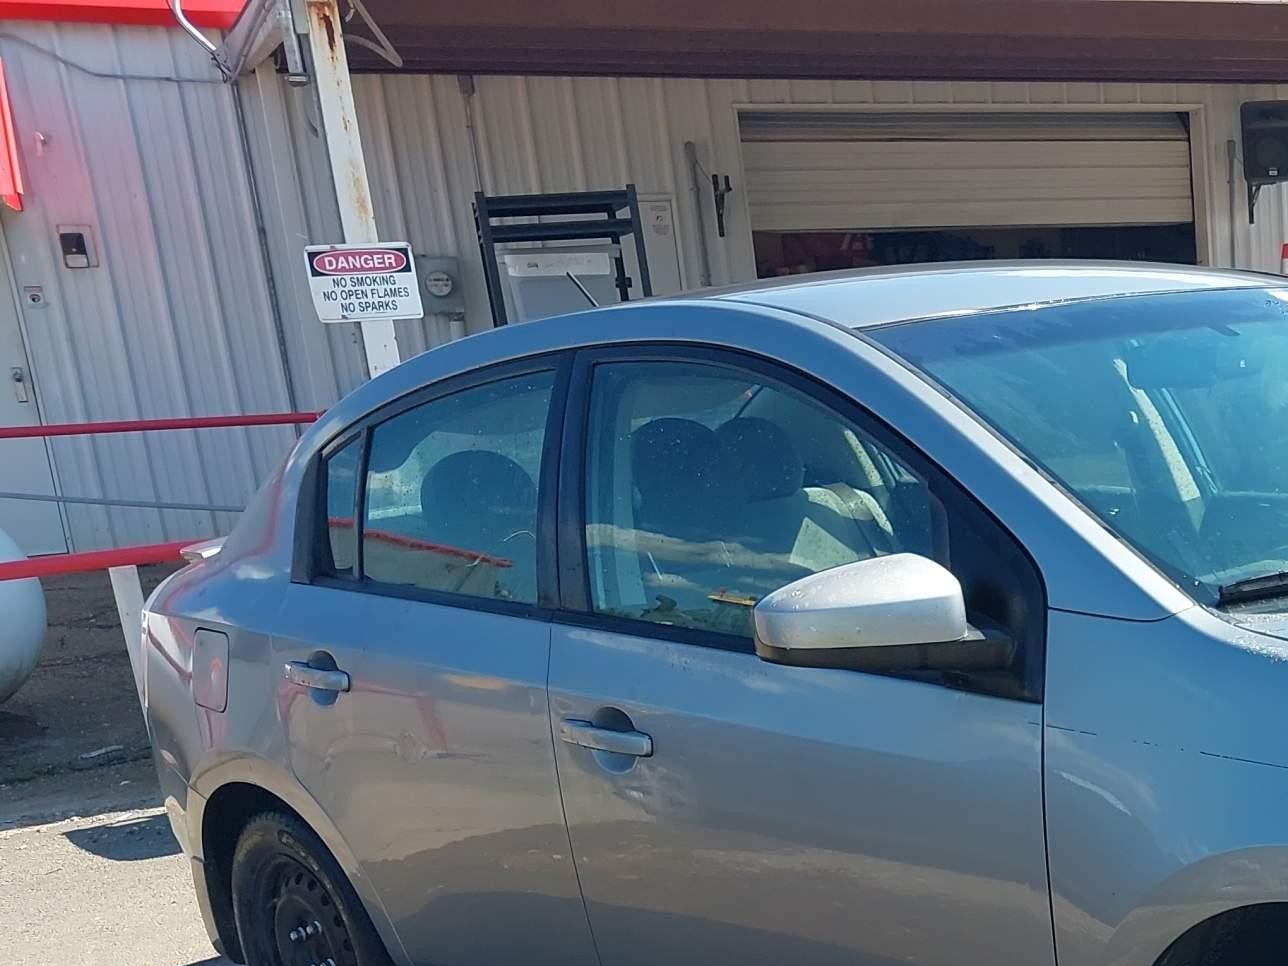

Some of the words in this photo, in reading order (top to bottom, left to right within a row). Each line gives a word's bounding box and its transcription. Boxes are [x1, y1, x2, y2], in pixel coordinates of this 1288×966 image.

[324, 254, 396, 270] DANGER
[332, 277, 348, 288] NO
[350, 275, 396, 288] SMOKING
[323, 291, 338, 301] NO
[340, 288, 369, 300] OPEN
[371, 287, 410, 299] FLAMES
[341, 302, 356, 313] NO
[358, 300, 398, 312] SPARKS
